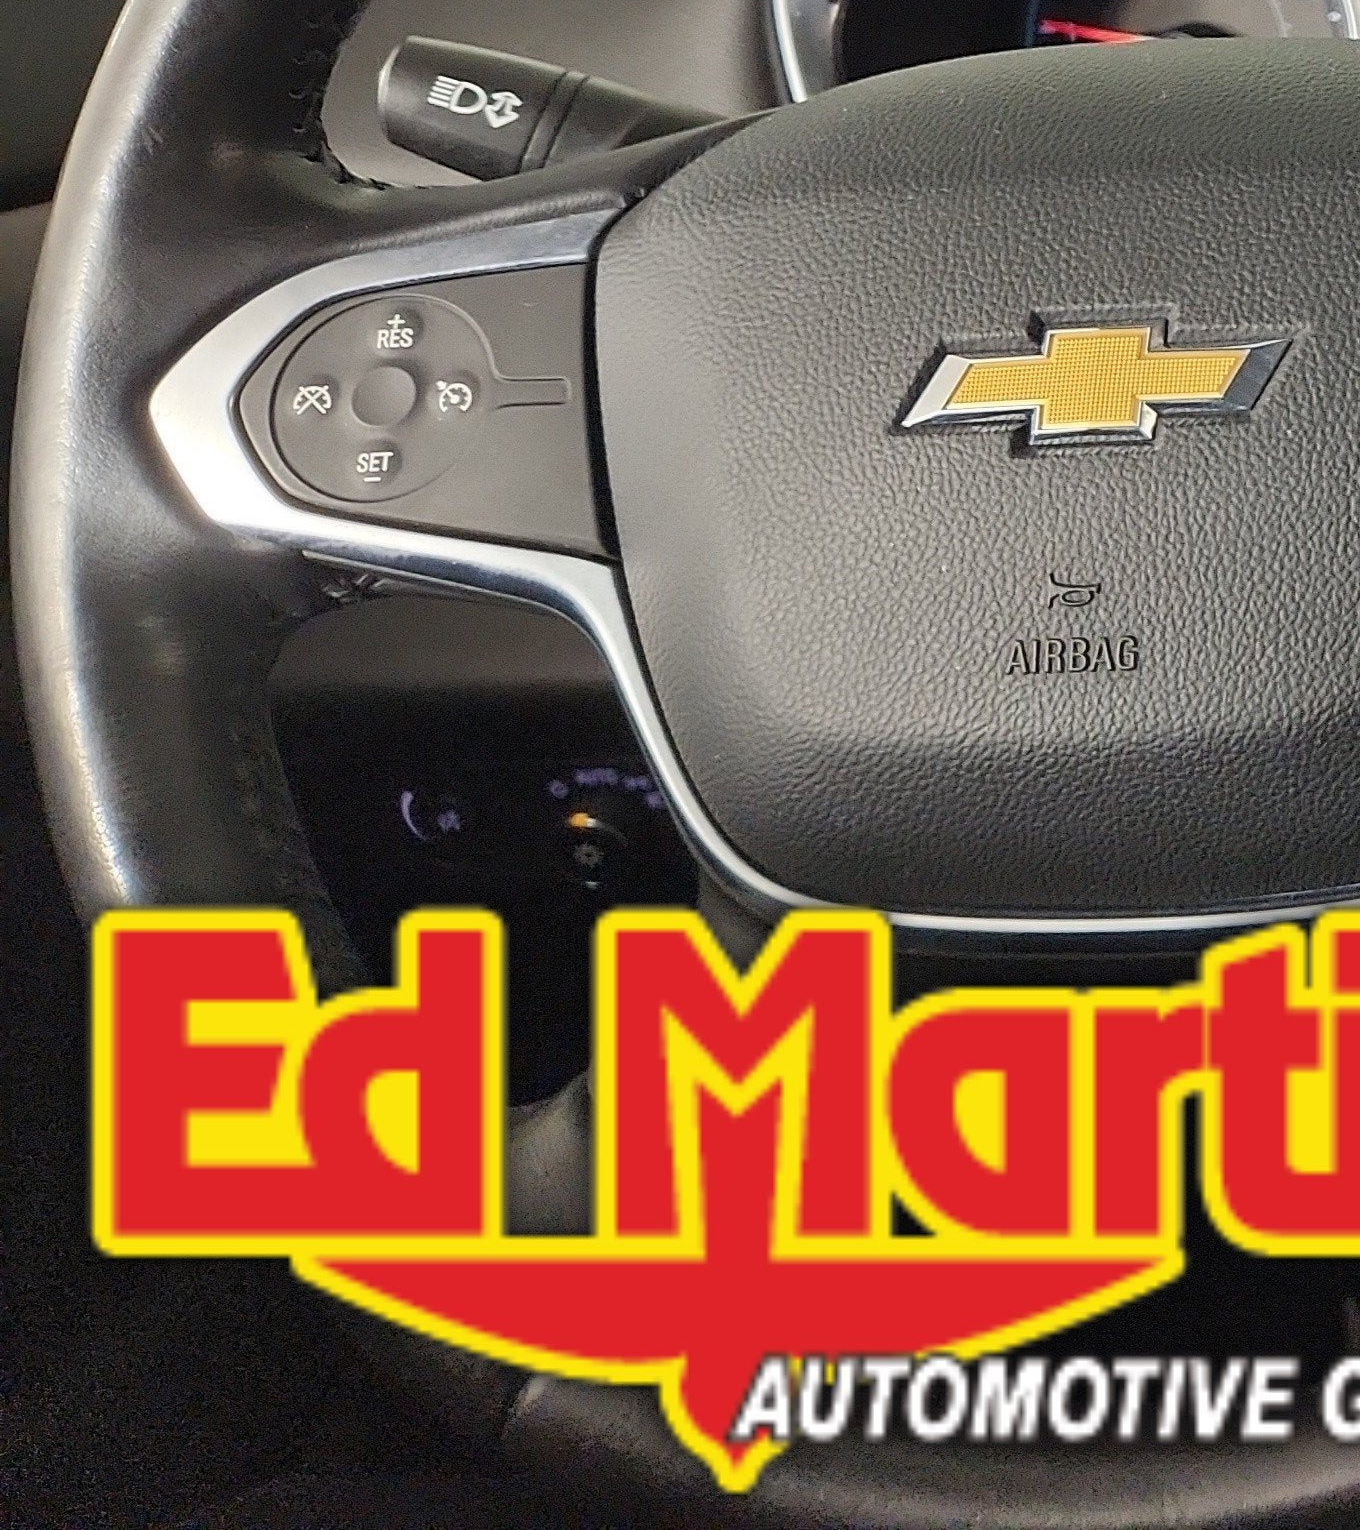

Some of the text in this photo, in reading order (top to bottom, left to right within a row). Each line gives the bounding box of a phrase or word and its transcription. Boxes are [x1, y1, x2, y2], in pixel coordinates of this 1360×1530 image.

[376, 327, 414, 349] RES
[355, 450, 394, 473] SET
[1005, 634, 1140, 676] AIRBAG
